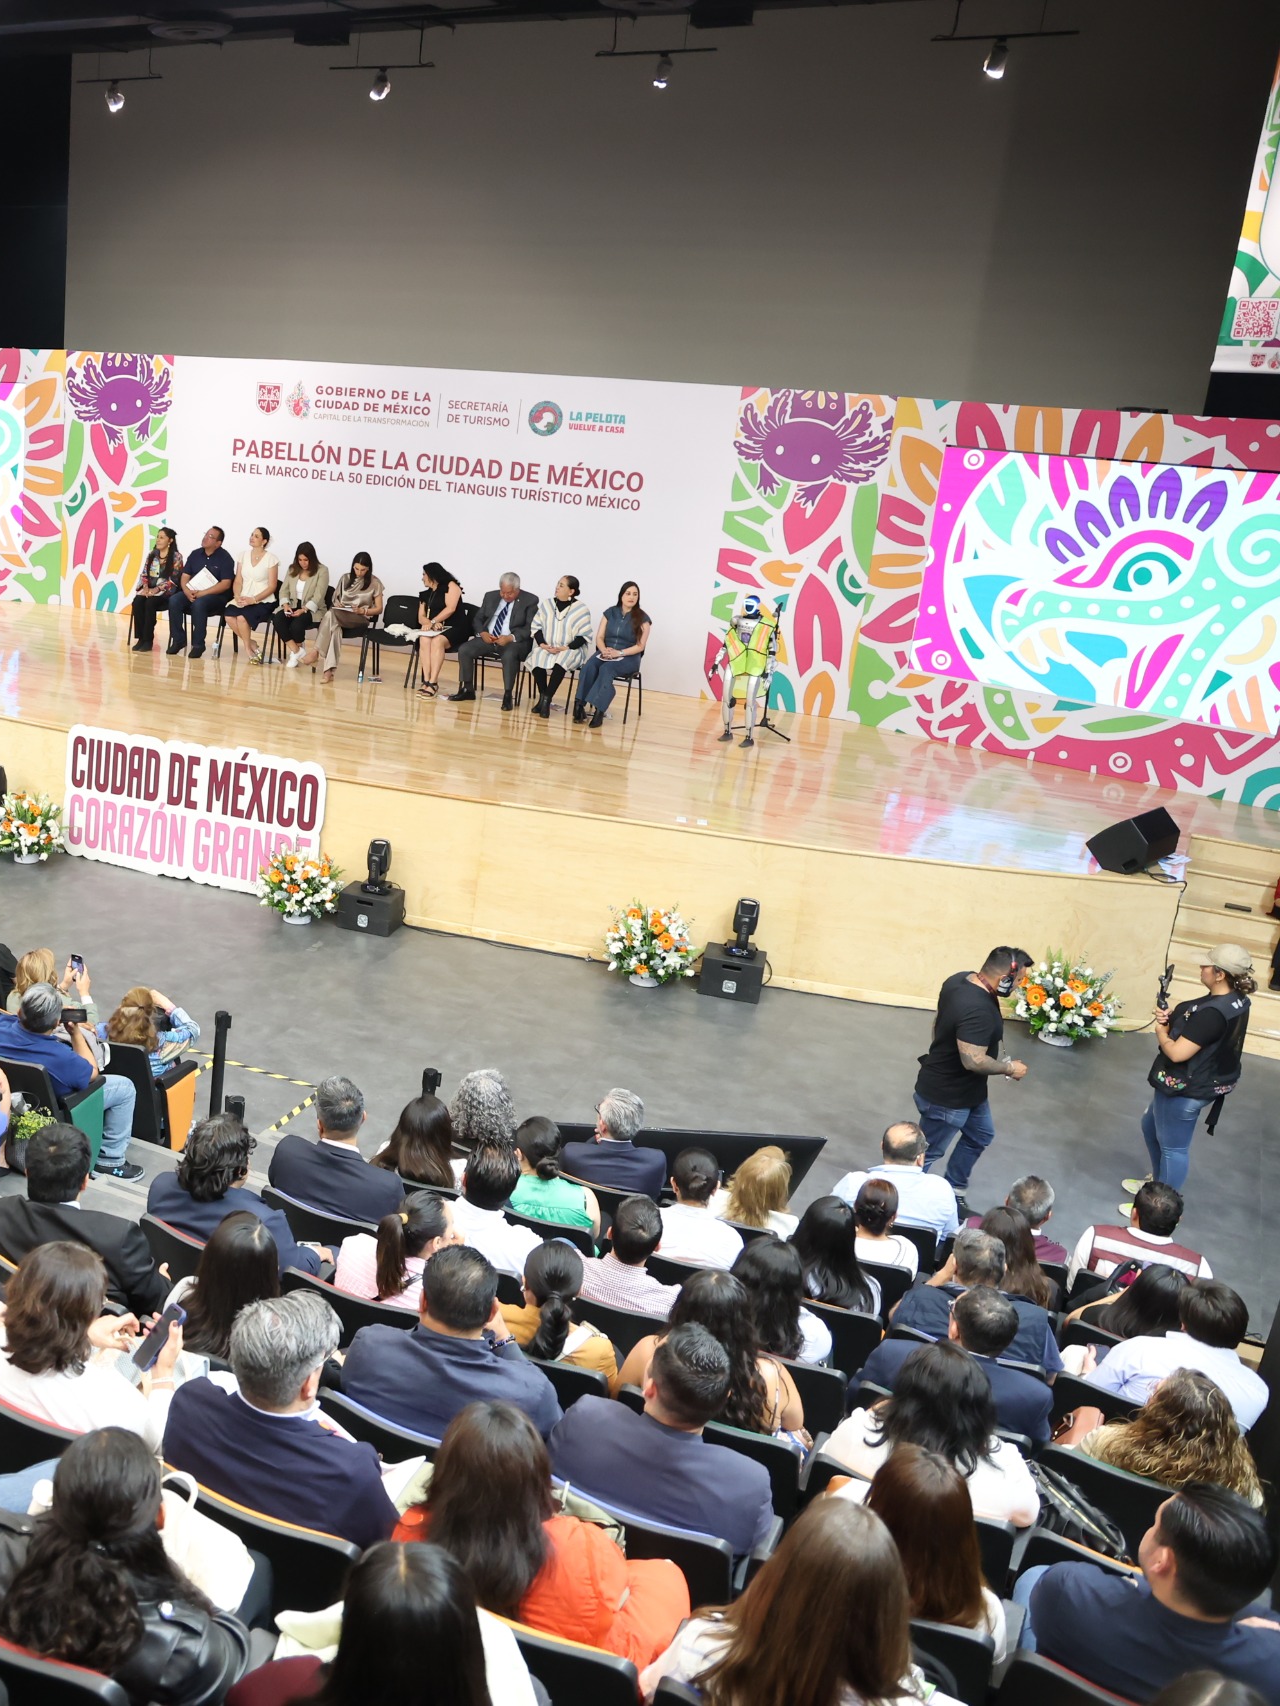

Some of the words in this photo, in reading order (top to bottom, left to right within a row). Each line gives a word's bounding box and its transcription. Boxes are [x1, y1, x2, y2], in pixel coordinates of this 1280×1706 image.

[315, 385, 386, 399] GOBIERNO
[391, 390, 408, 400] DE
[414, 392, 431, 402] LA
[314, 400, 360, 411] CIUDAD
[363, 402, 379, 412] DE
[383, 402, 431, 416] MÉXICO
[448, 400, 508, 413] SECRETARÍA
[314, 413, 341, 422] CAPITAL
[363, 416, 430, 428] TRANSFORMACIÓN
[447, 414, 460, 423] DE
[463, 415, 510, 427] TURISMO
[570, 411, 583, 421] LA
[585, 412, 626, 424] PELOTA
[569, 423, 596, 432] VUELVE
[232, 438, 342, 465] PABELLÓN
[348, 448, 376, 468] DE
[382, 450, 409, 471] LA
[416, 453, 502, 479] CIUDAD
[510, 461, 541, 483] DE
[547, 462, 644, 492] MÉXICO
[231, 462, 246, 473] EN
[249, 464, 262, 474] EL
[265, 465, 308, 479] MARCO
[311, 469, 326, 481] DE
[330, 471, 344, 482] LA
[348, 473, 362, 483] 50
[366, 474, 415, 489] EDICIÓN
[419, 479, 442, 491] DEL
[446, 481, 507, 498] TIANGUIS
[511, 488, 582, 505] TURÍSTICO
[586, 494, 640, 511] MÉXICO
[71, 735, 161, 801] CIUDAD
[166, 752, 201, 810] DE
[206, 752, 319, 832] MÉXICO
[68, 794, 186, 867] CORAZÓN
[192, 818, 312, 882] GRAN
